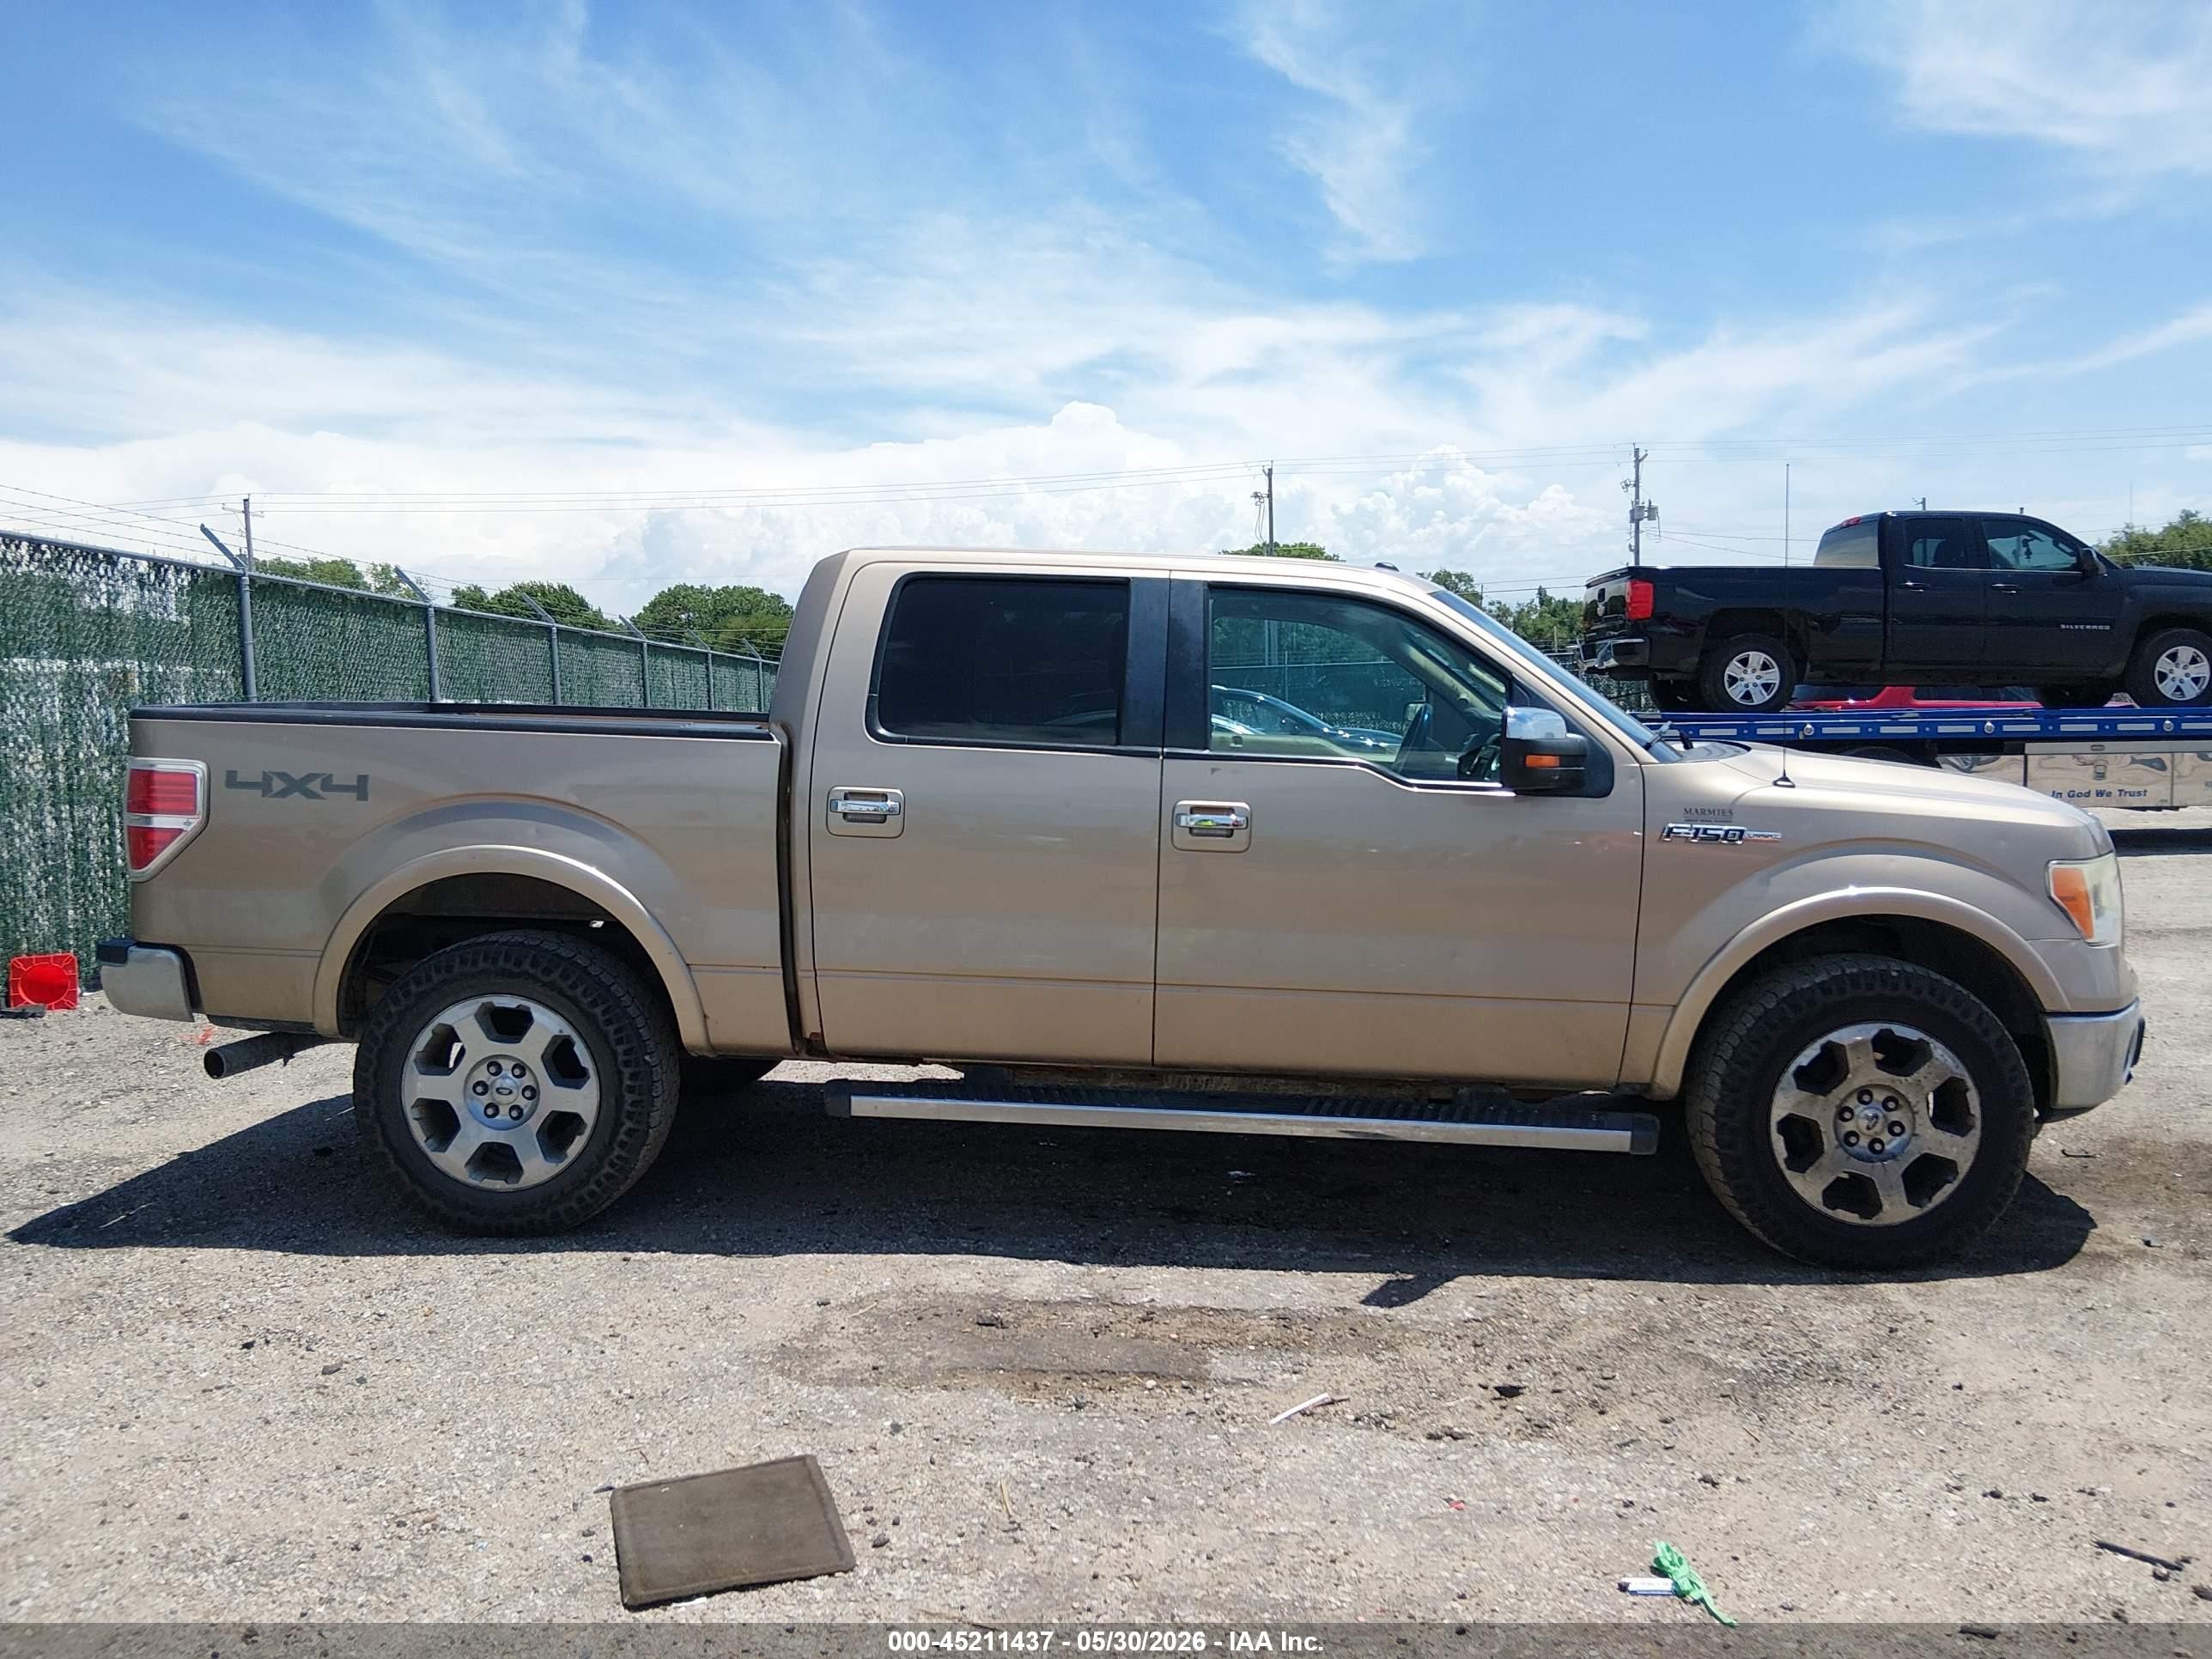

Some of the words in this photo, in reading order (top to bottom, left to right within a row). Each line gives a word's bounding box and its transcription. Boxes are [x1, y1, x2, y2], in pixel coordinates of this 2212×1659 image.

[2051, 790, 2063, 799] In
[2067, 789, 2091, 799] God
[2095, 789, 2112, 798] We
[2118, 788, 2148, 798] Trust
[1683, 807, 1734, 817] MARMIES
